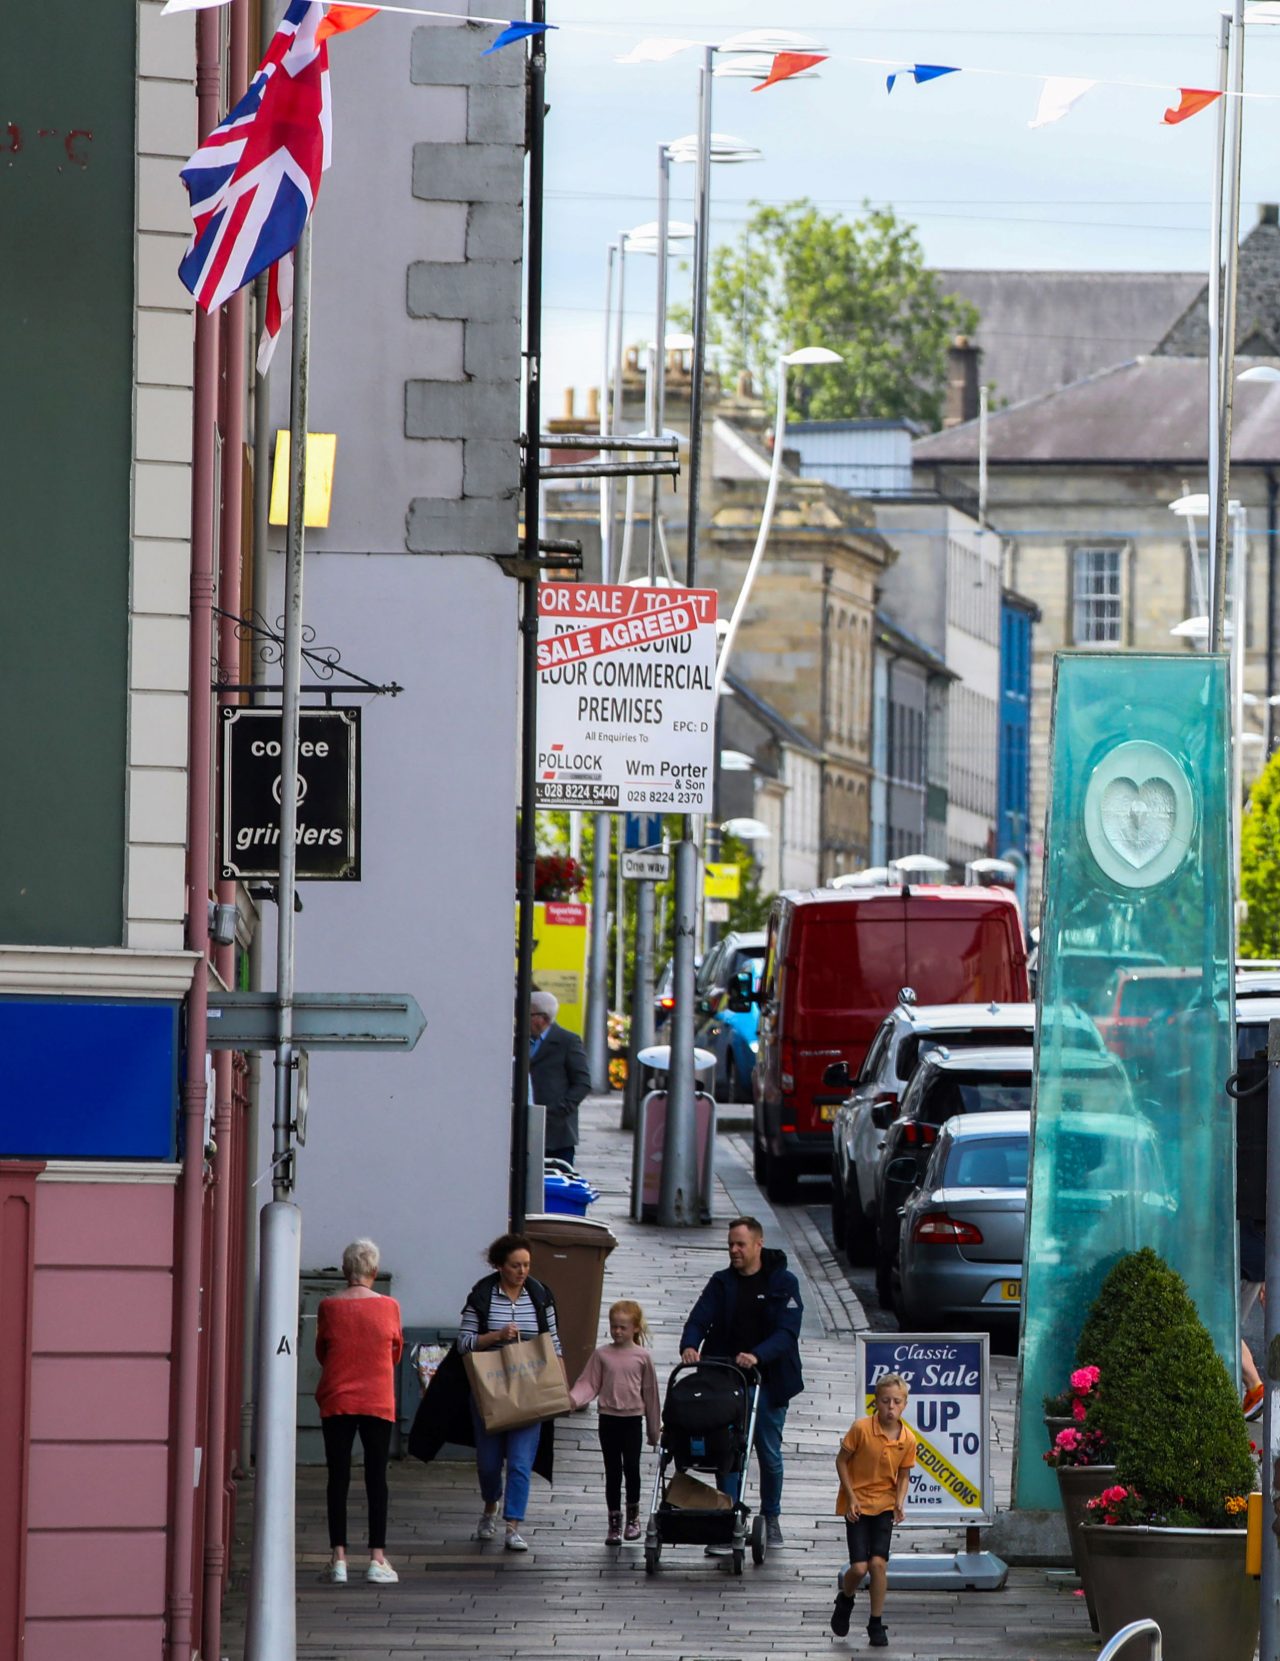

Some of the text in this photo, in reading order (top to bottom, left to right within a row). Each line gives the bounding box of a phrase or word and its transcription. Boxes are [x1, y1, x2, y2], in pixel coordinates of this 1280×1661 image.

[538, 589, 570, 611] OR
[575, 590, 622, 613] SALE
[643, 593, 670, 611] TO
[538, 608, 689, 666] SALE AGREED
[541, 661, 712, 690] LOOR COMMERCIAL
[578, 696, 663, 724] PREMISES
[673, 721, 708, 732] EPC: D
[585, 731, 648, 743] All Enquiries To
[251, 738, 329, 757] coee
[538, 753, 603, 771] POLLOCK
[626, 760, 708, 778] Wm Porter
[544, 784, 563, 797] 028
[565, 784, 590, 799] 8224
[593, 785, 618, 800] 5440
[674, 779, 705, 790] & Son
[627, 791, 703, 804] 028 8224 2370
[626, 859, 666, 874] One way
[276, 1335, 291, 1355] A
[894, 1344, 957, 1361] Classic
[487, 1360, 546, 1379] PRMARK
[921, 1364, 979, 1387] Sale
[917, 1401, 960, 1432] UP
[949, 1432, 980, 1455] TO
[916, 1442, 978, 1506] REDUCTIONS
[907, 1496, 942, 1504] Lines
